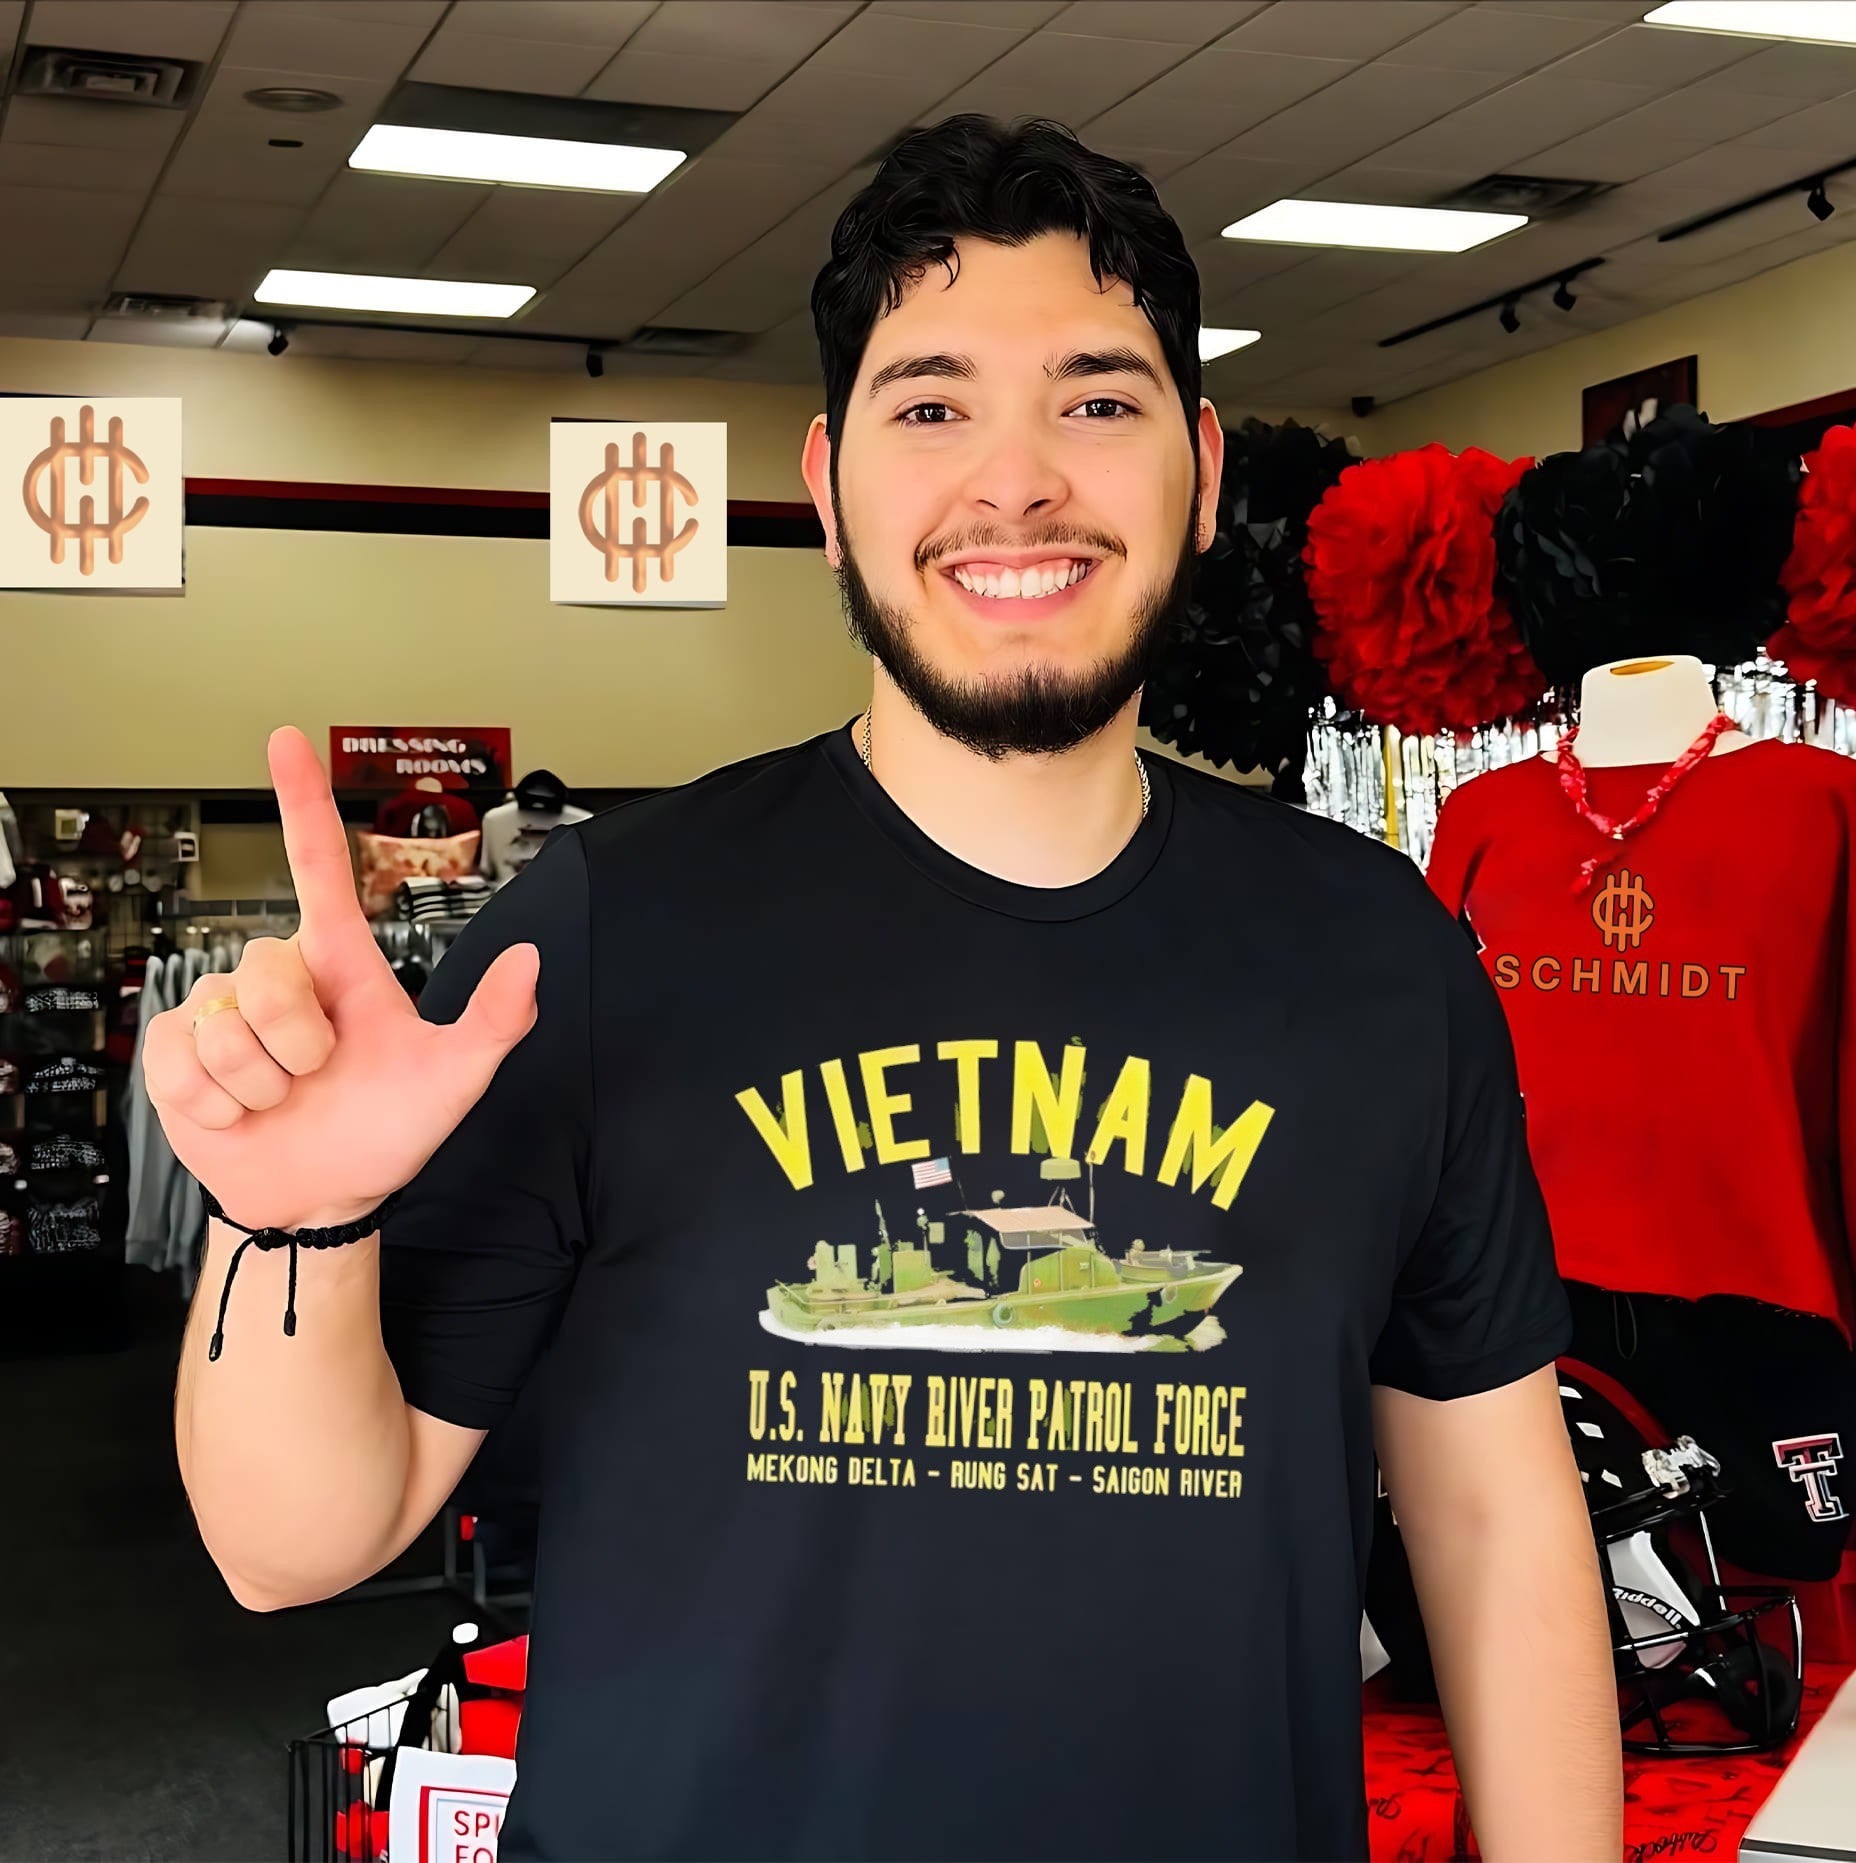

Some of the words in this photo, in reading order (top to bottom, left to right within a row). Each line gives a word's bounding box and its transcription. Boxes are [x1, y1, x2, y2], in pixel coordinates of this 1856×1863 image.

[1494, 954, 1747, 1000] SCHMIDT
[734, 1039, 1276, 1212] VIETNAM
[748, 1369, 804, 1442] U.S.
[819, 1371, 912, 1446] NAVY
[925, 1375, 1013, 1449] RIVER
[1026, 1378, 1138, 1454] PATROL
[1153, 1383, 1247, 1457] FORCE
[746, 1453, 838, 1484] MEKONG
[848, 1456, 916, 1487] DELTA
[950, 1460, 1007, 1491] RUNG
[1016, 1462, 1059, 1493] SAT
[1092, 1464, 1170, 1496] SAIGON
[1179, 1468, 1243, 1499] RIVER
